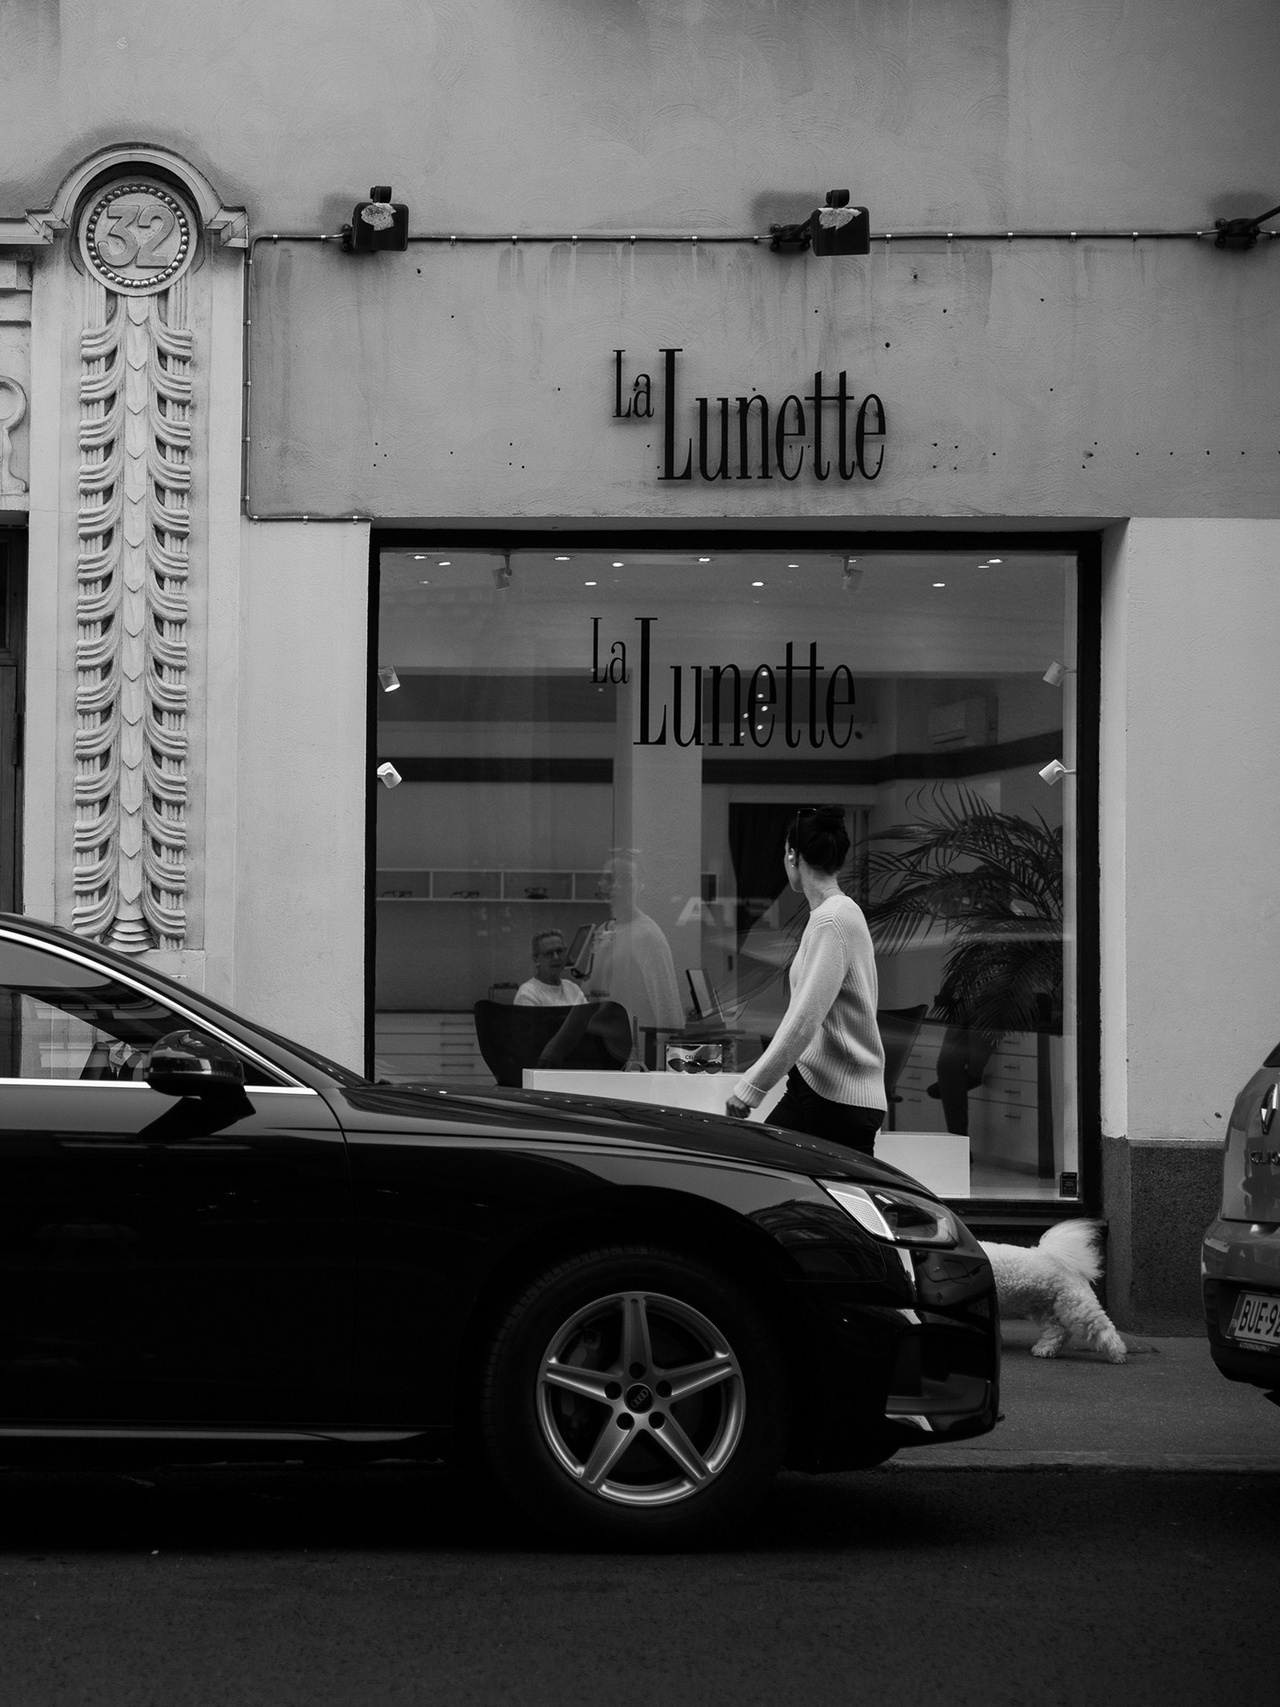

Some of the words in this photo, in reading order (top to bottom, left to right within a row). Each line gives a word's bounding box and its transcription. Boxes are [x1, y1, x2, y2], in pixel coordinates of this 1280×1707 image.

[97, 204, 175, 268] 32
[612, 349, 654, 418] La
[657, 348, 887, 481] Lunette
[589, 617, 630, 684] La
[633, 617, 856, 749] Lunette
